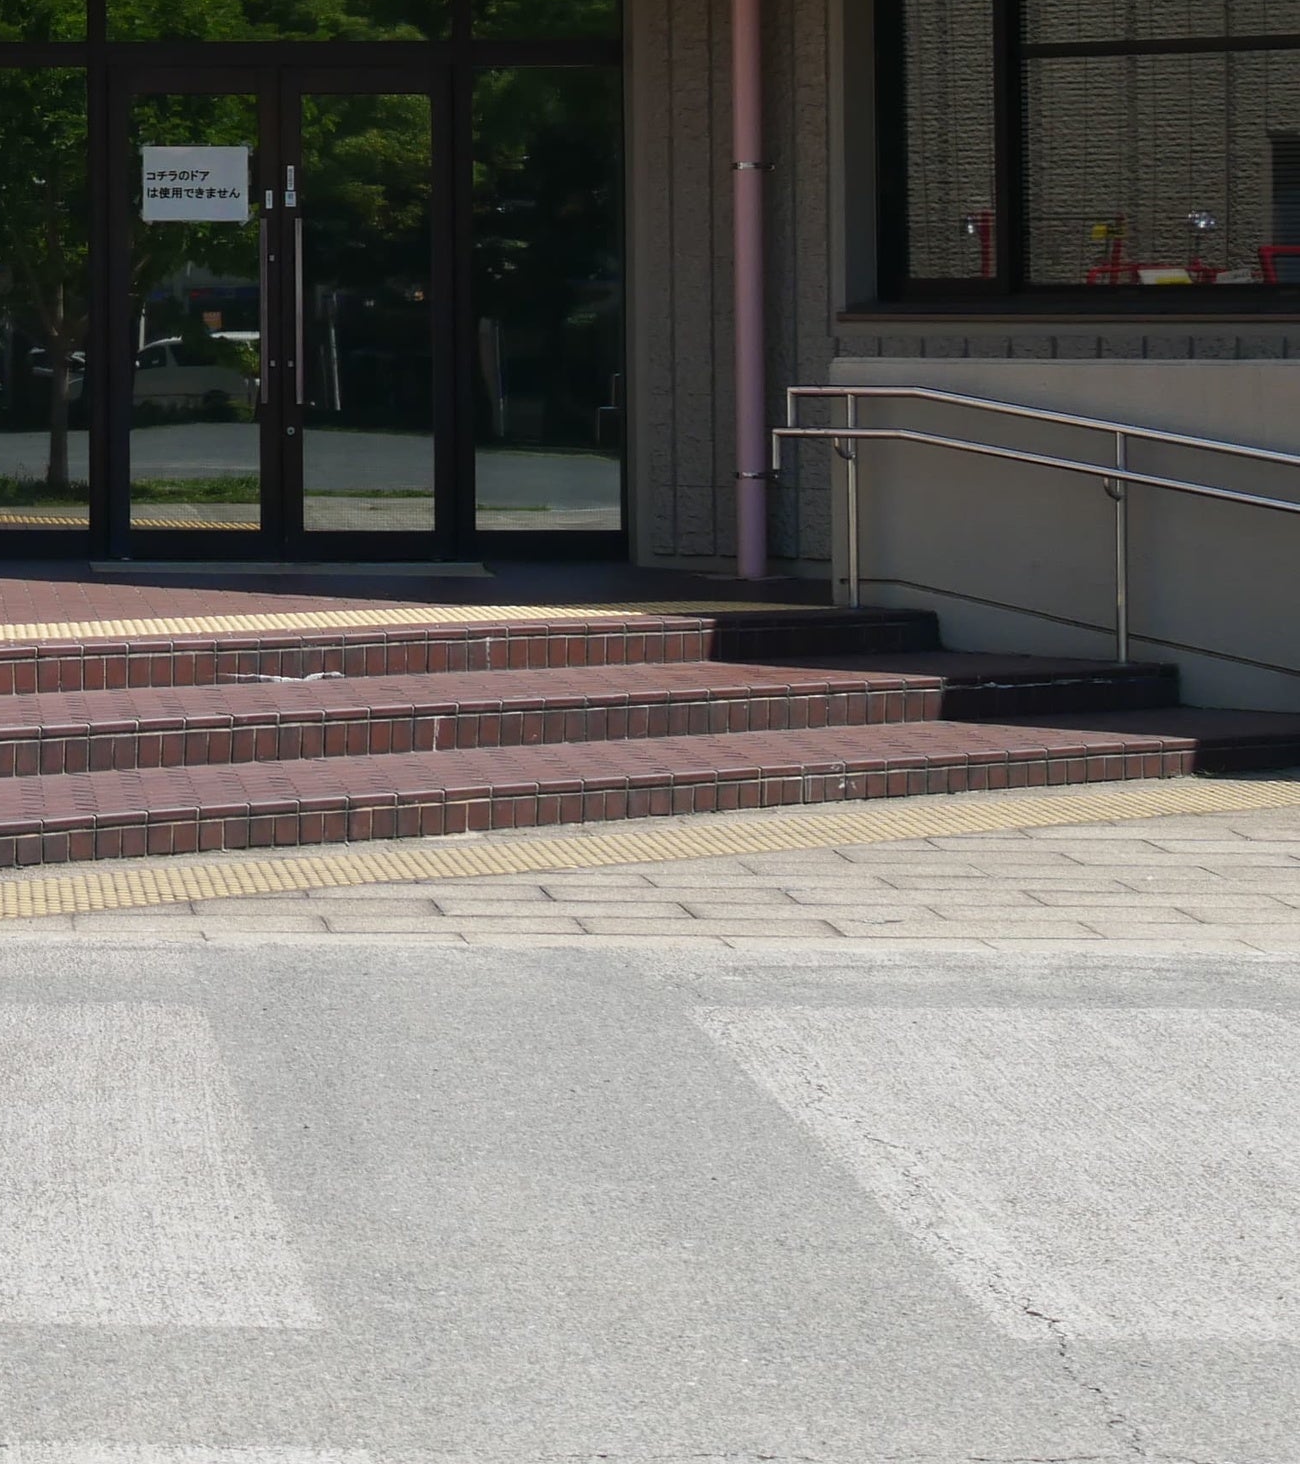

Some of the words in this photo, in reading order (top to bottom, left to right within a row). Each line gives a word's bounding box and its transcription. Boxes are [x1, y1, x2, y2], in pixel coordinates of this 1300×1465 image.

[146, 170, 210, 182] コチラのドア
[146, 187, 241, 199] は使用できません
